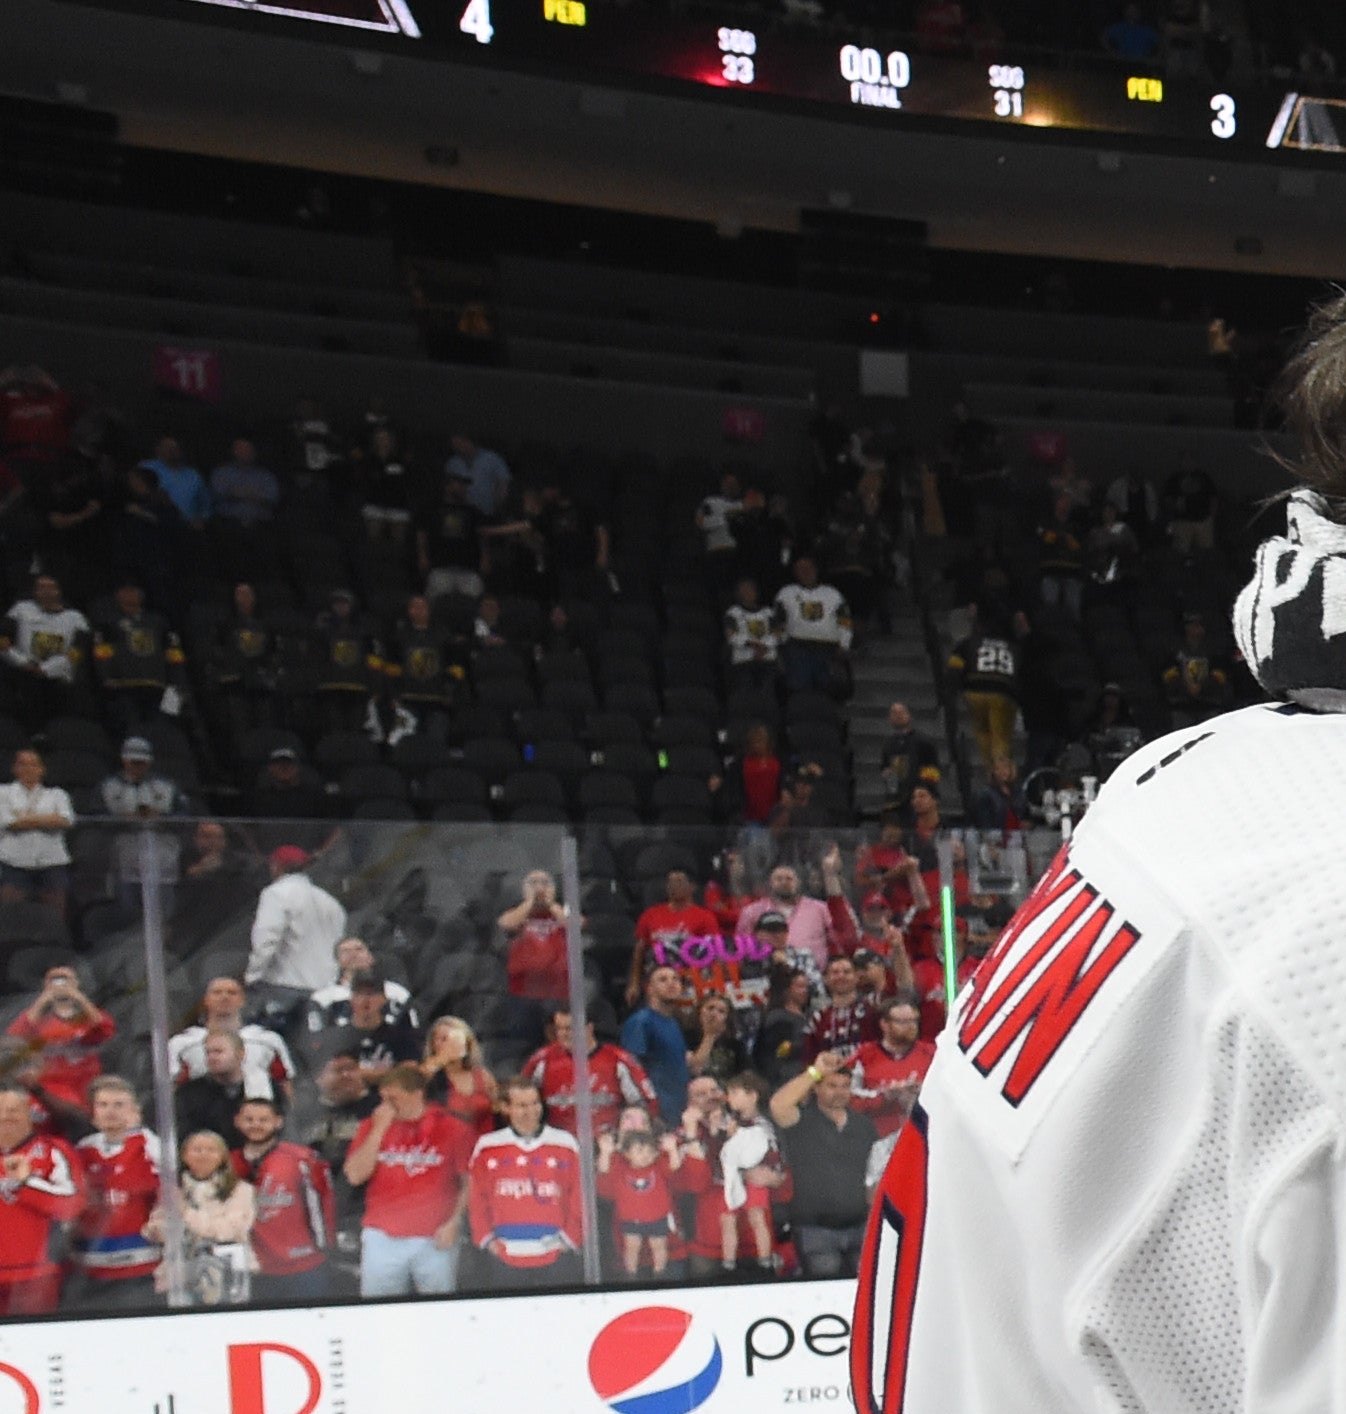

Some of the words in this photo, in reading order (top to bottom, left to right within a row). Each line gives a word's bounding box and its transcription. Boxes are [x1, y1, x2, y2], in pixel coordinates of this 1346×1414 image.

[460, 0, 494, 44] 4
[1210, 94, 1236, 139] 3
[745, 1313, 850, 1377] pe
[783, 1385, 840, 1403] ZERO
